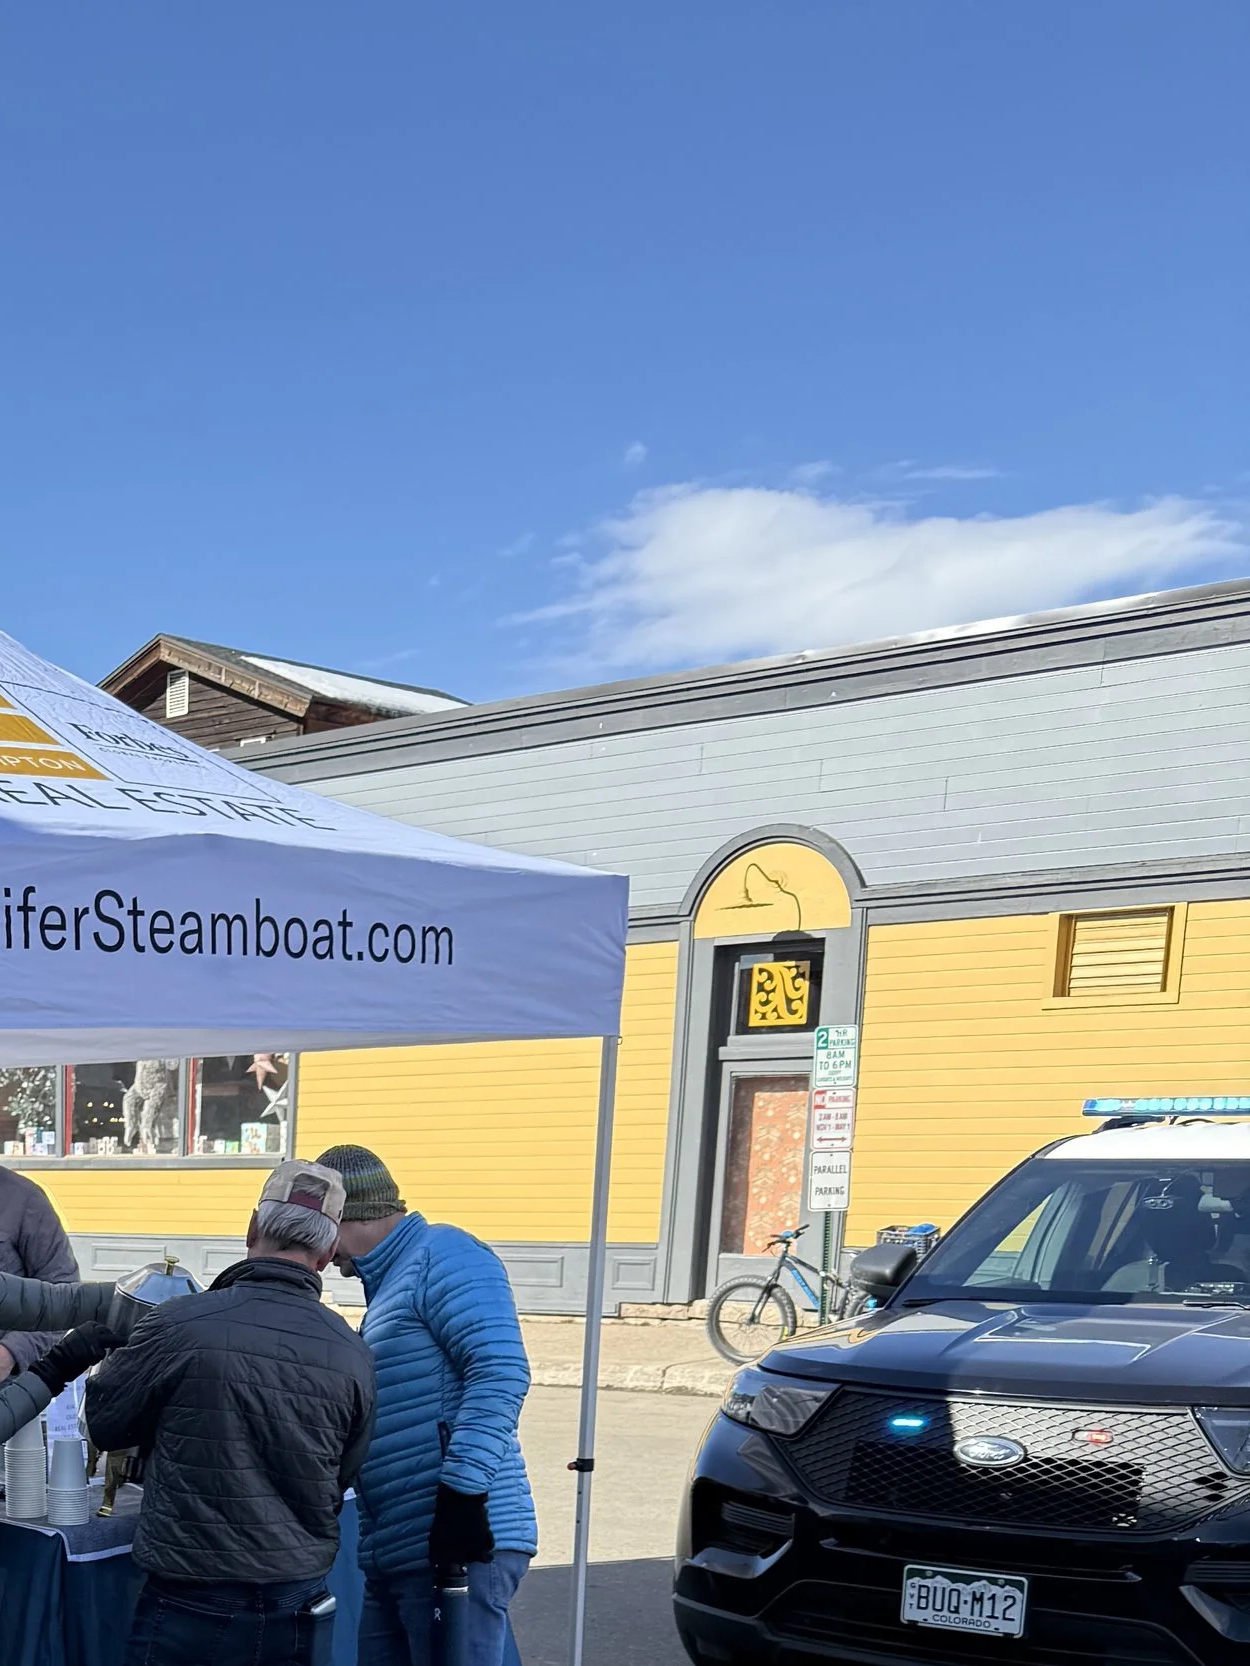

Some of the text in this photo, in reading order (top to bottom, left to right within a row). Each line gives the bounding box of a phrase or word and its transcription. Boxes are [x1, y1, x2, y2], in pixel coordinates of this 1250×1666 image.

[119, 787, 338, 831] ESTATE
[817, 1030, 828, 1048] 2
[829, 1038, 856, 1046] PARKING
[820, 1062, 830, 1070] TO
[814, 1164, 847, 1174] PARALLEL
[815, 1186, 845, 1196] PARKING
[932, 1614, 991, 1628] COLORADO
